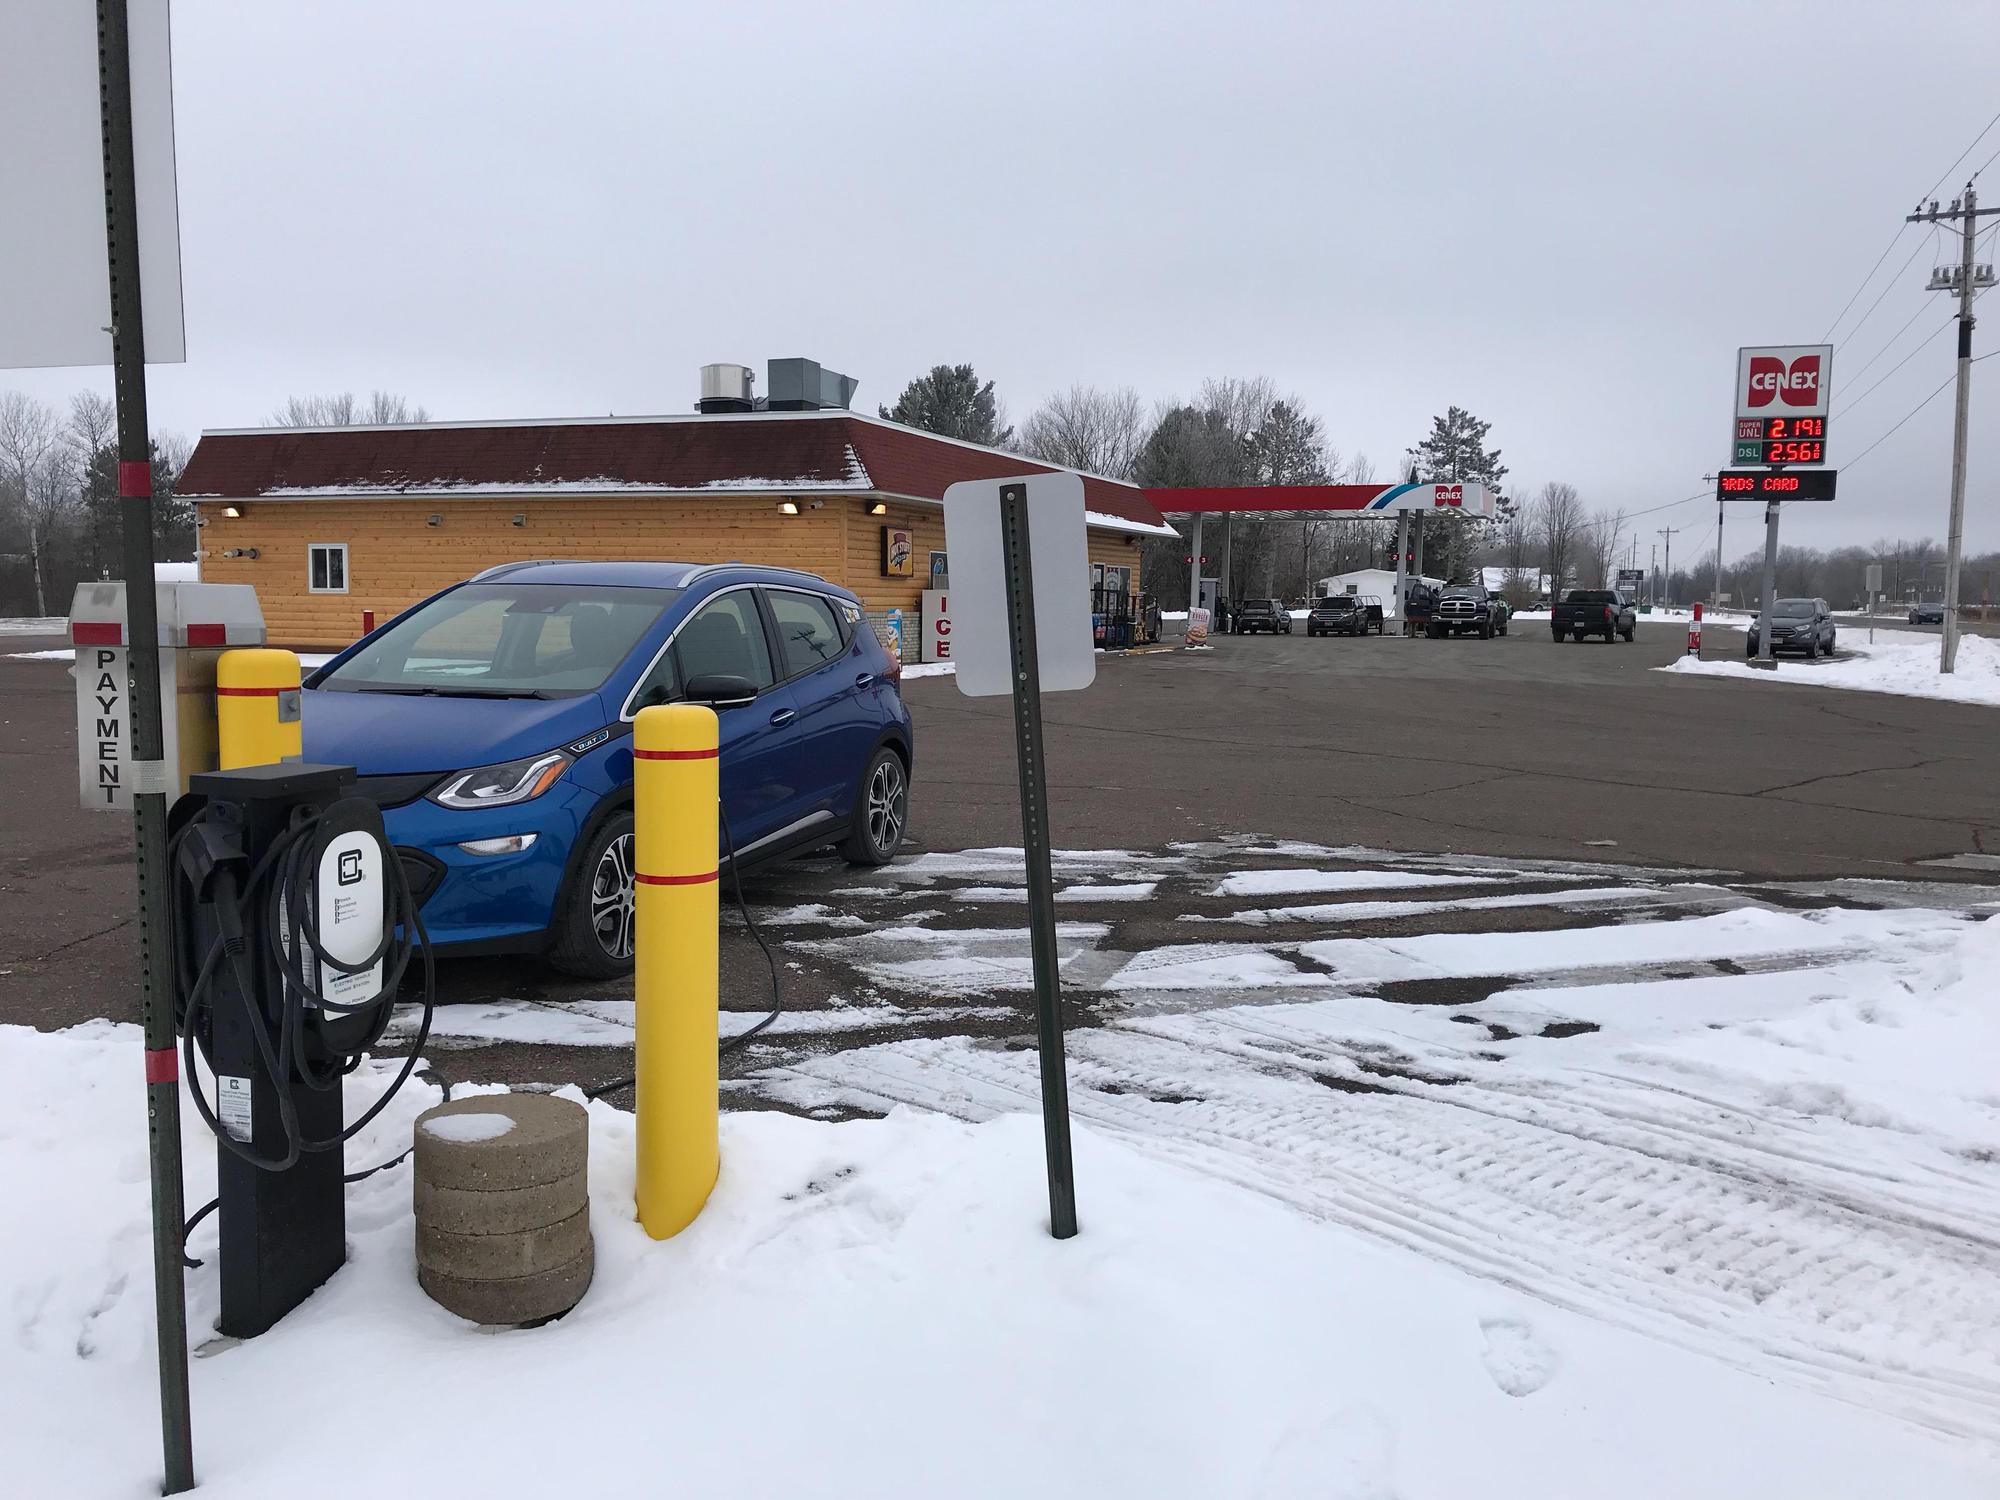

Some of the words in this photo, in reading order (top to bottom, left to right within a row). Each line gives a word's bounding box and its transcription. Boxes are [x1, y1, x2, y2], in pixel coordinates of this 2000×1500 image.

[1751, 371, 1817, 390] CENEX
[1739, 421, 1761, 429] SUPER
[1738, 428, 1761, 438] UNL
[1738, 447, 1759, 458] DSL
[1770, 443, 1811, 461] 2.56
[1763, 478, 1799, 491] CARD
[1436, 491, 1462, 500] CENEX
[935, 596, 952, 658] ICE
[95, 649, 121, 804] PAYMENT
